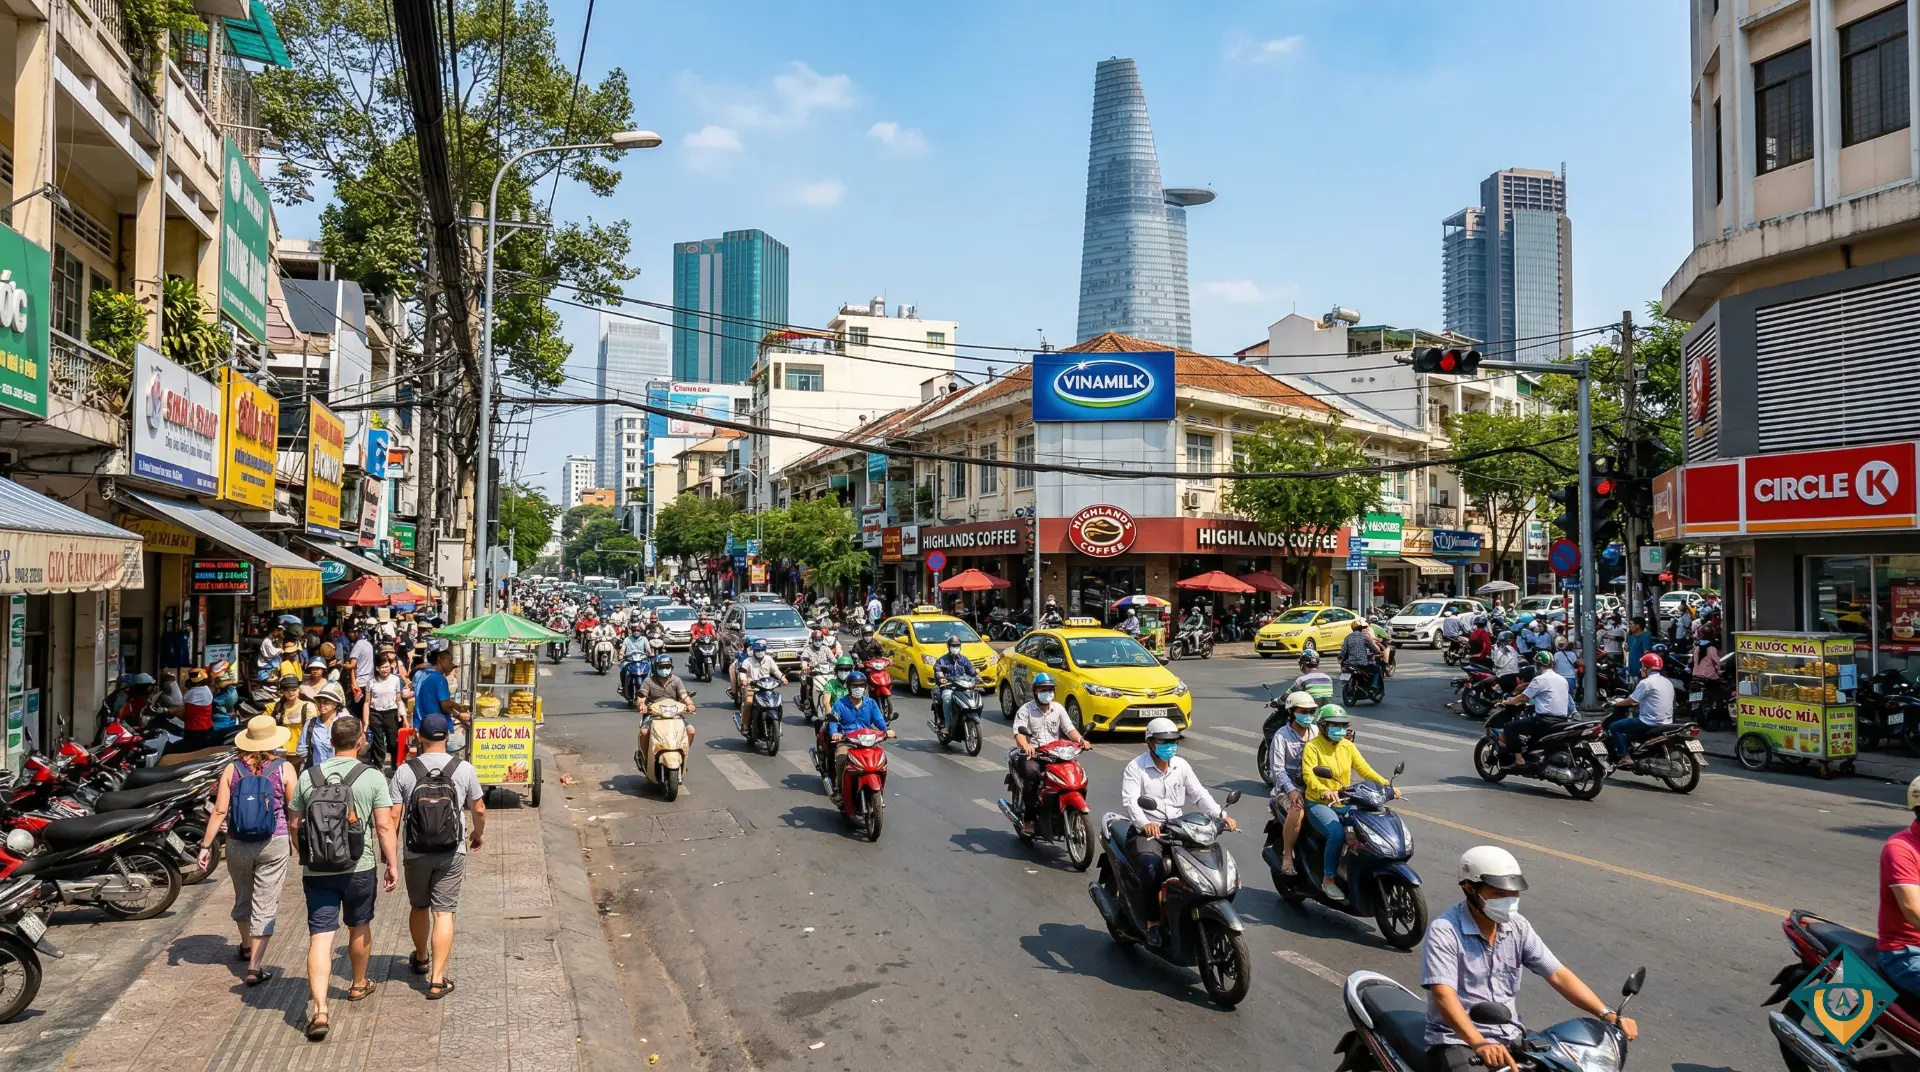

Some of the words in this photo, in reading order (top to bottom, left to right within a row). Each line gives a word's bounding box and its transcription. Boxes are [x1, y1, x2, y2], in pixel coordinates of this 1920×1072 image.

[1063, 374, 1145, 389] VINAMILK
[1754, 473, 1849, 502] CIRCLE
[1866, 469, 1894, 502] K
[1073, 505, 1133, 529] HIGHLANDS
[923, 532, 974, 549] HIGHLANDS
[977, 529, 1016, 546] COFFEE
[1199, 529, 1285, 547] HIGHLANDS
[1080, 542, 1124, 555] COFFEE
[1740, 641, 1752, 650] XE
[1792, 642, 1816, 654] MÍA
[1740, 704, 1755, 715] XE
[1759, 705, 1792, 720] NƯỚC
[476, 728, 487, 739] XE
[489, 725, 512, 739] NƯỚC
[514, 726, 530, 739] MÍA
